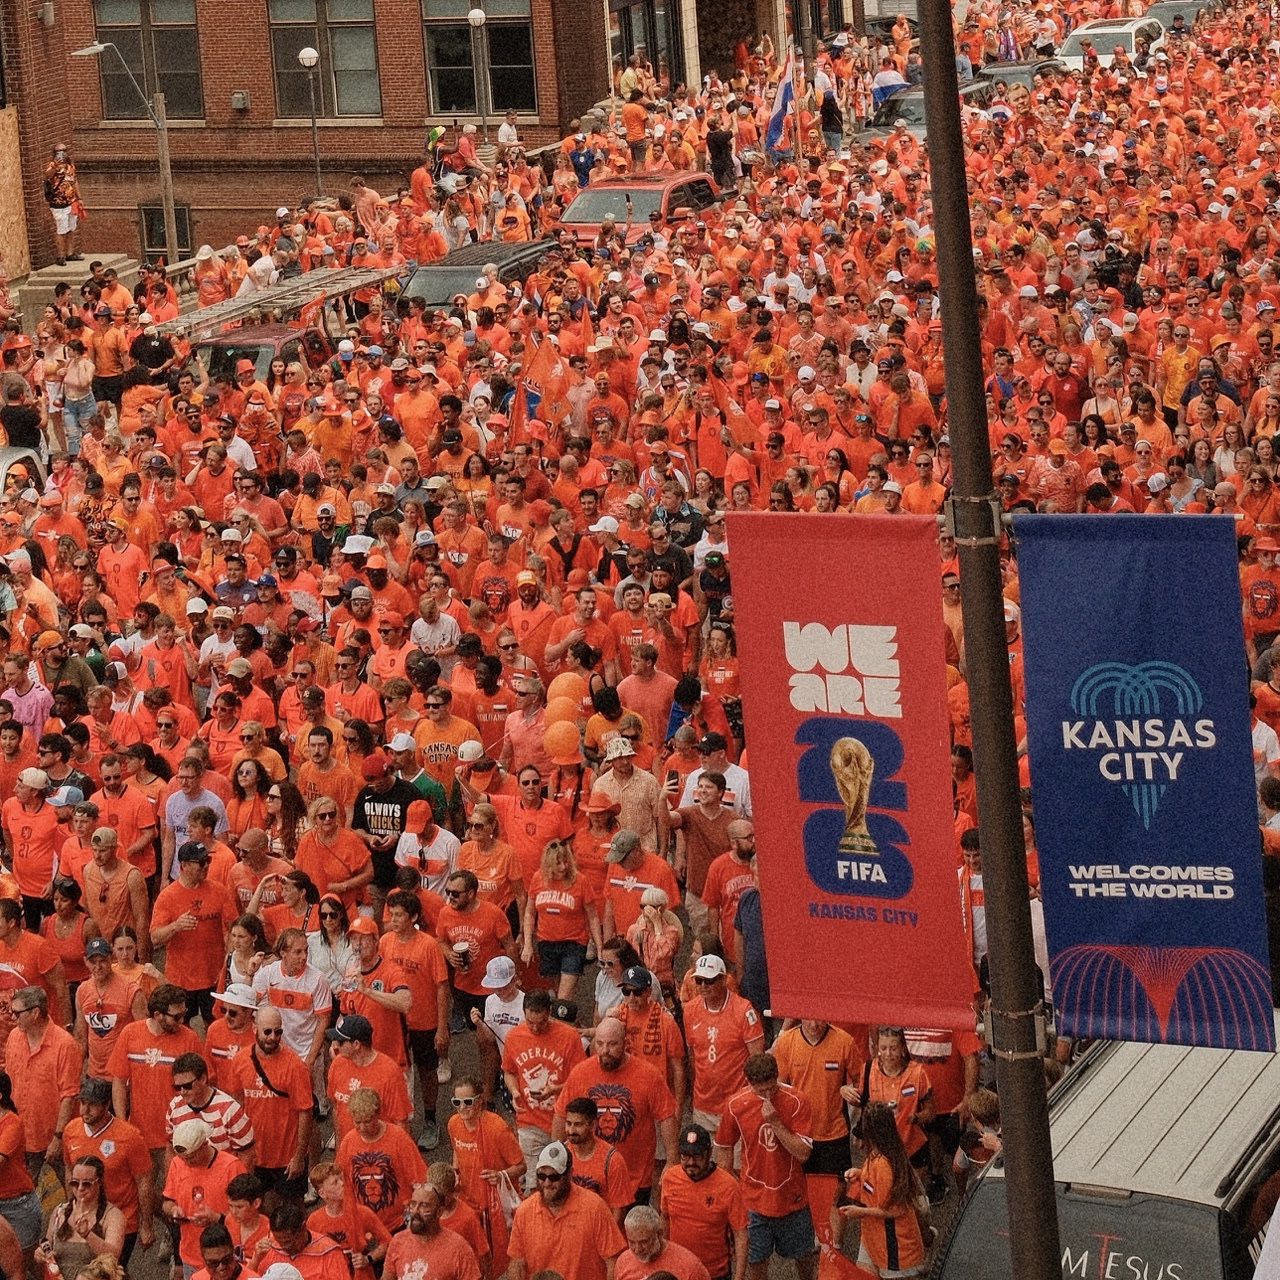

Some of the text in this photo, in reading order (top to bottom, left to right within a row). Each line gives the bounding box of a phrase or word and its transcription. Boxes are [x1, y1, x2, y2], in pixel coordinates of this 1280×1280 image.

[782, 621, 900, 677] WE
[789, 673, 902, 719] ARE
[1062, 718, 1216, 750] KANSAS
[429, 753, 450, 763] CITY
[1099, 751, 1184, 782] CITY
[364, 801, 401, 816] ALWAYS
[836, 860, 887, 884] FIFA
[1069, 865, 1234, 882] WELCOMES
[536, 890, 575, 909] NEDERLAND
[1069, 882, 1234, 900] THE WORLD
[808, 904, 919, 928] KANSAS CITY
[447, 924, 483, 937] NEDERLAND
[89, 1012, 111, 1029] KC
[516, 1047, 564, 1071] EDERLAN
[708, 1044, 716, 1062] 8
[764, 1127, 776, 1147] 12
